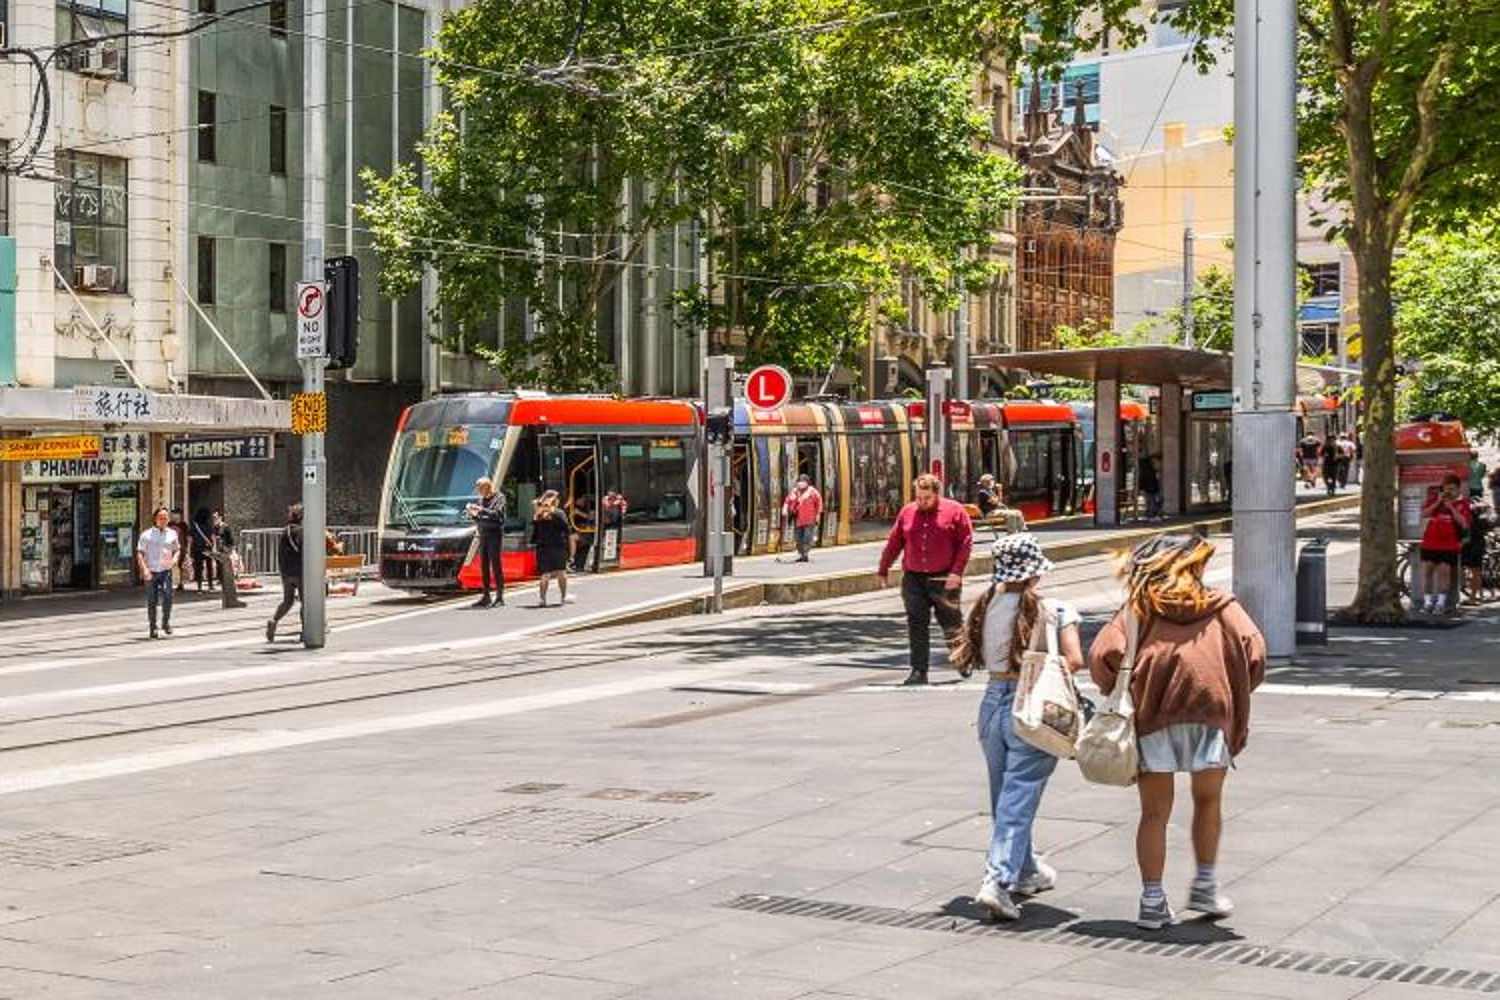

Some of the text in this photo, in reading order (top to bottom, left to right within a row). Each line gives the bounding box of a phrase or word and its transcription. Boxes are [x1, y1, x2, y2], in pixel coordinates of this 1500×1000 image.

[303, 321, 319, 333] NO
[758, 375, 776, 400] L
[95, 390, 151, 419] 旅行社
[295, 399, 321, 413] END
[103, 437, 118, 452] ET
[169, 440, 245, 459] CHEMIST
[39, 459, 115, 477] PHARMACY
